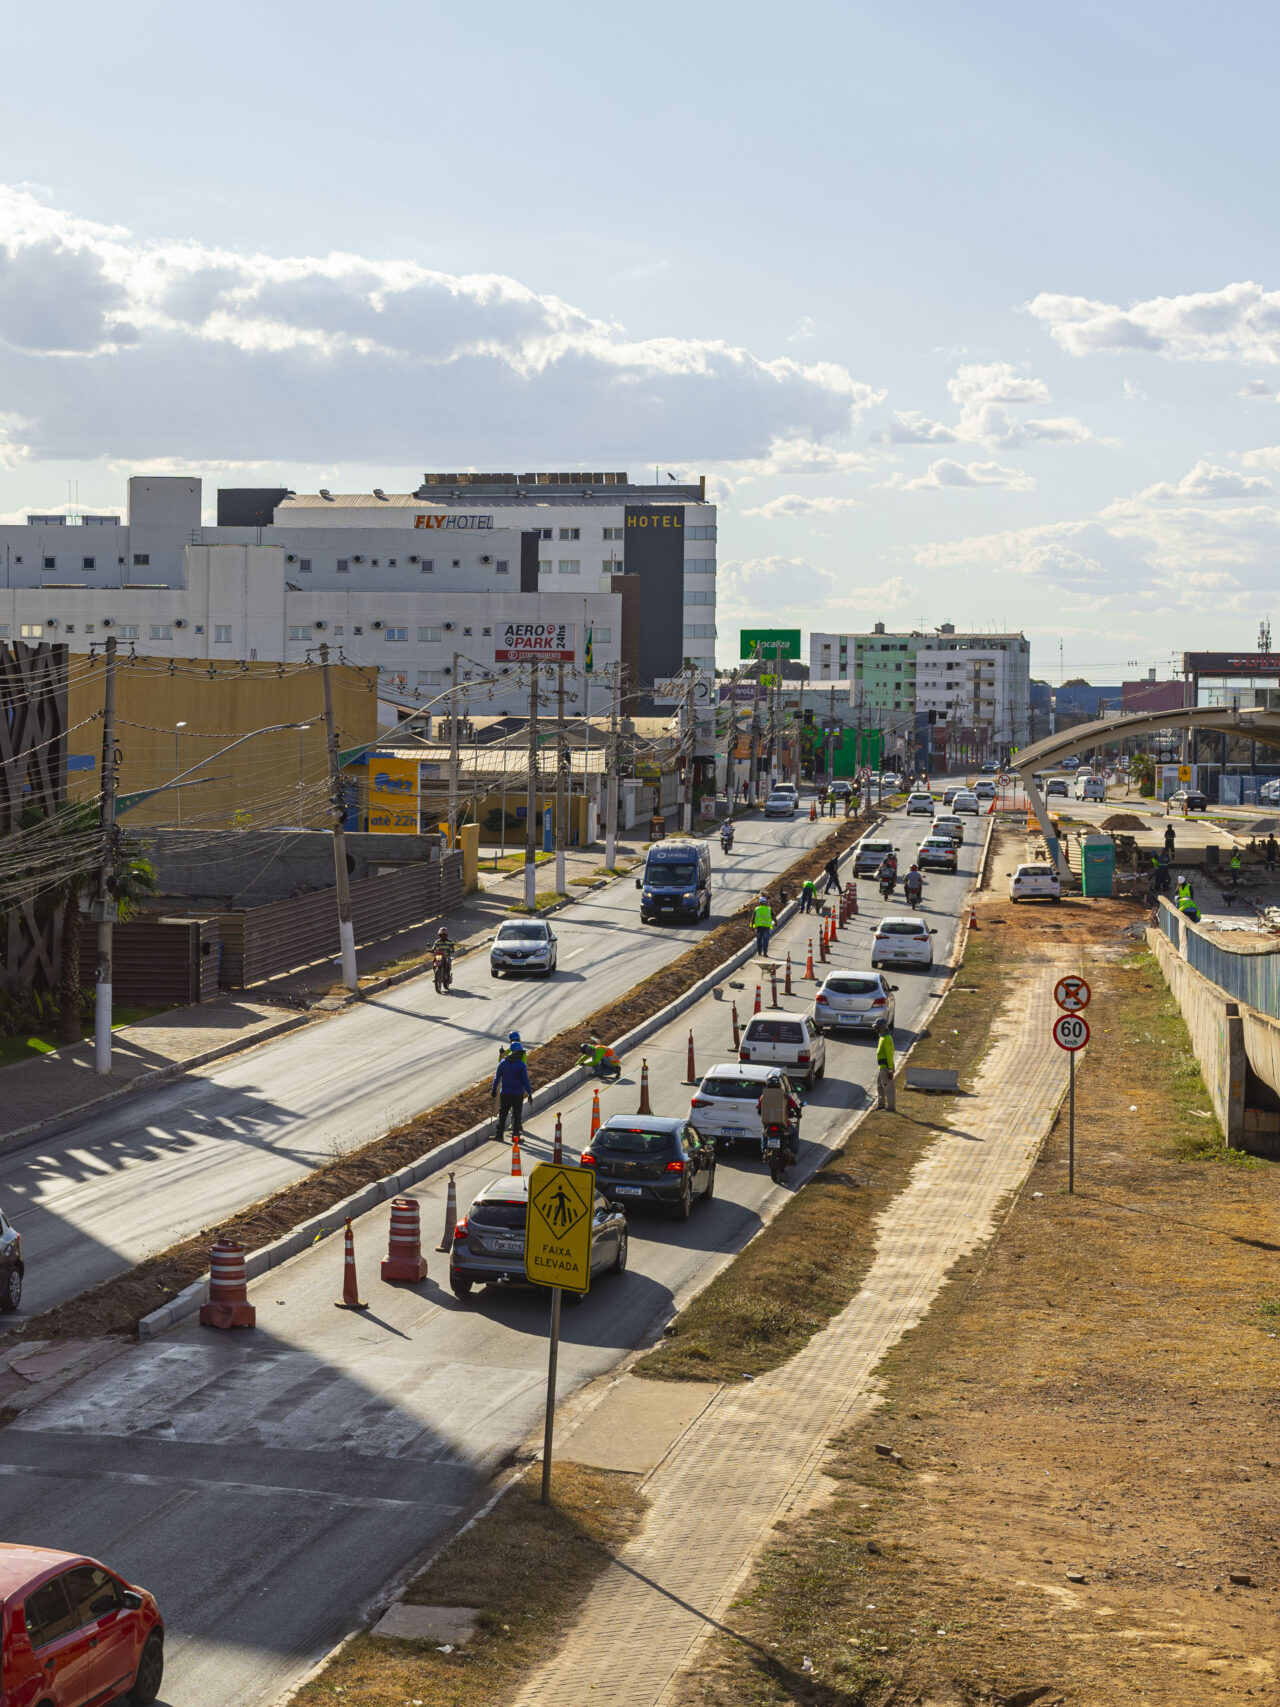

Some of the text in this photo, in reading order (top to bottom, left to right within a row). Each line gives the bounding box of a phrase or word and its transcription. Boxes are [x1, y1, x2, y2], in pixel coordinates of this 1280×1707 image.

[627, 515, 682, 528] HOTEL
[504, 624, 545, 636] AERO
[556, 624, 566, 649] 24hs
[514, 637, 554, 649] PARK
[757, 639, 790, 648] Localiza
[371, 815, 417, 827] até 22h
[1061, 1021, 1083, 1038] 60
[542, 1244, 572, 1258] FAIXA
[534, 1256, 579, 1273] ELEVADA
